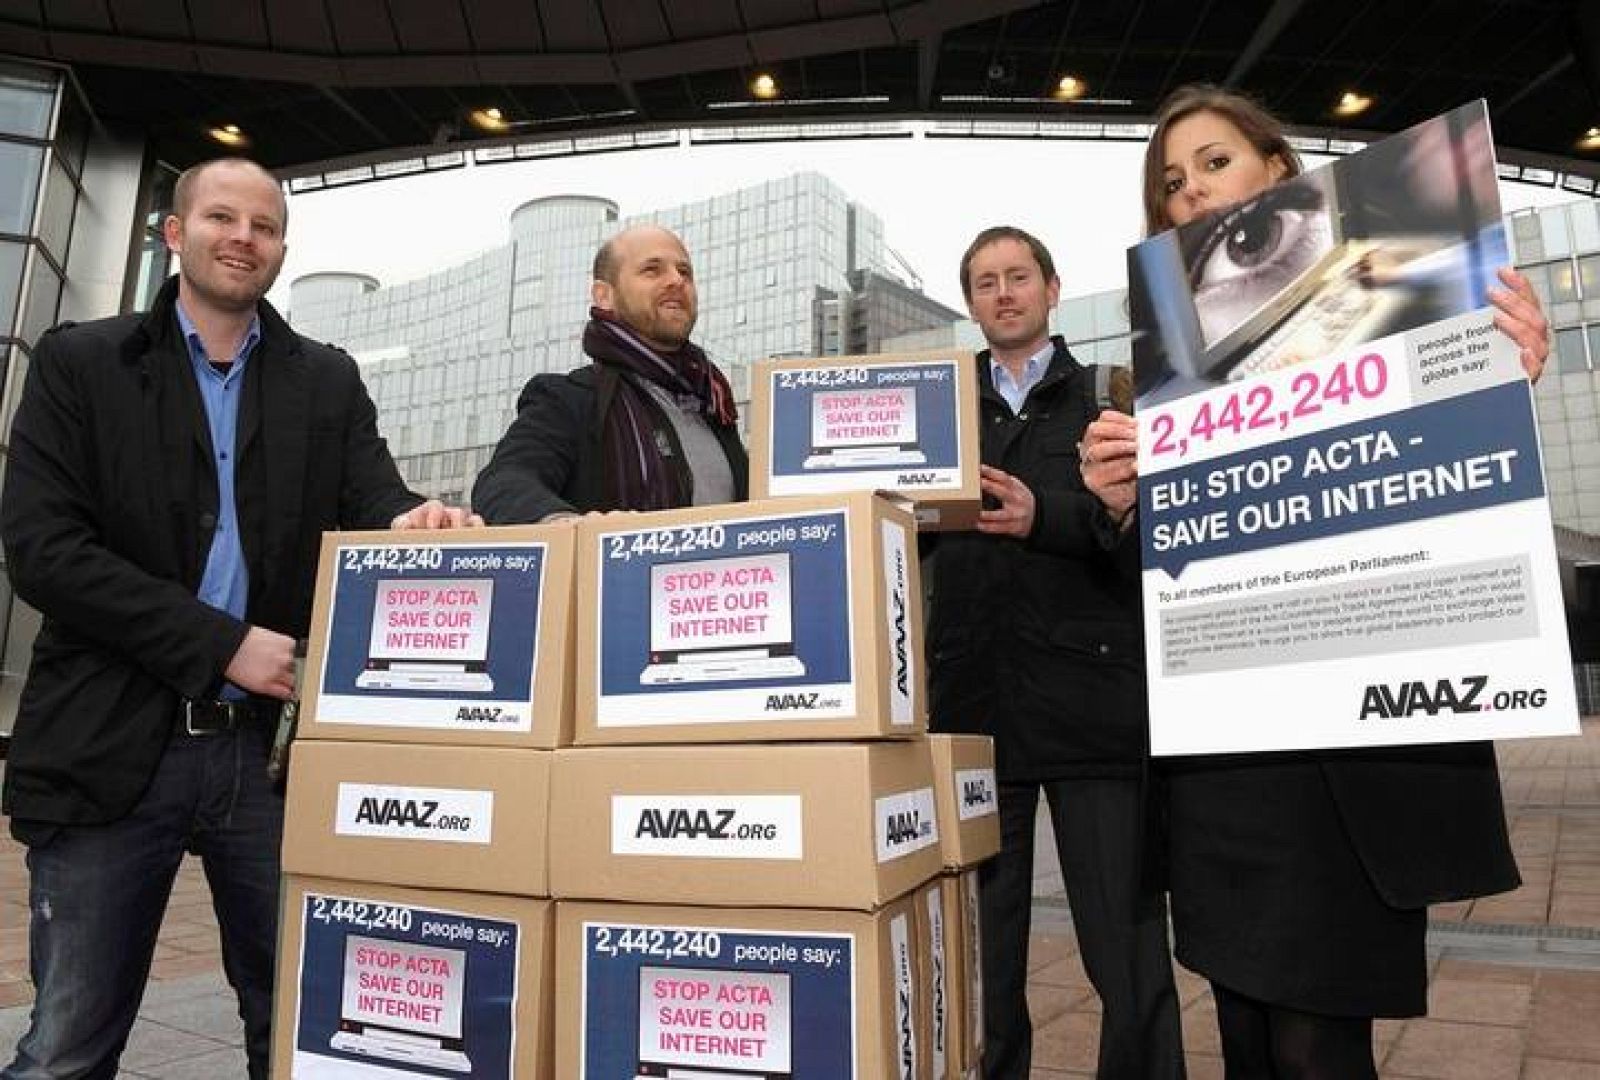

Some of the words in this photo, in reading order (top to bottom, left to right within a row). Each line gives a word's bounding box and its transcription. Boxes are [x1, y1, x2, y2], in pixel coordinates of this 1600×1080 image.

[1418, 332, 1462, 354] people
[1420, 350, 1464, 368] across
[1467, 342, 1489, 354] the
[780, 369, 869, 389] 2,442,240
[878, 370, 920, 384] people
[924, 370, 949, 381] say:
[1422, 366, 1458, 384] globe
[1462, 358, 1491, 374] say:
[822, 396, 863, 410] STOP
[866, 394, 905, 408] ACTA
[1151, 352, 1388, 456] 2,442,240
[826, 412, 862, 425] SAVE
[868, 410, 901, 422] OUR
[826, 424, 900, 439] INTERNET
[1152, 476, 1199, 512] EU:
[1207, 454, 1293, 498] STOP
[1302, 430, 1398, 478] ACTA
[1409, 436, 1423, 446] -
[1152, 513, 1230, 551] SAVE
[1238, 496, 1311, 535] OUR
[1322, 450, 1519, 519] INTERNET
[610, 527, 724, 561] 2,442,240
[736, 528, 796, 548] people
[801, 524, 837, 544] say:
[345, 549, 442, 574] 2,442,240
[451, 555, 502, 570] people
[505, 556, 536, 572] say:
[664, 570, 718, 592] STOP
[720, 567, 774, 588] ACTA
[1159, 590, 1172, 602] To
[1189, 582, 1242, 596] members
[1246, 579, 1258, 590] of
[1260, 575, 1281, 586] the
[1284, 564, 1347, 582] European
[1350, 550, 1432, 572] Parliament:
[386, 590, 430, 606] STOP
[433, 590, 479, 606] ACTA
[669, 596, 718, 616] SAVE
[724, 591, 768, 610] OUR
[388, 612, 430, 628] SAVE
[434, 612, 472, 628] OUR
[670, 615, 770, 639] INTERNET
[386, 633, 470, 650] INTERNET
[1360, 676, 1547, 720] AVAAZ.ORG
[355, 797, 470, 831] AVAAZ.ORG
[635, 809, 776, 840] AVAAZ.ORG
[312, 900, 412, 932] 2,442,240
[422, 921, 474, 942] people
[478, 928, 510, 948] say:
[595, 928, 721, 958] 2,442,240
[734, 943, 799, 966] people
[802, 946, 842, 968] say:
[356, 950, 401, 969] STOP
[405, 954, 450, 978] ACTA
[359, 973, 400, 994] SAVE
[406, 979, 444, 1000] OUR
[654, 979, 710, 1002] STOP
[716, 984, 774, 1006] ACTA
[358, 996, 442, 1024] INTERNET
[659, 1006, 712, 1028] SAVE
[718, 1010, 766, 1032] OUR
[659, 1032, 766, 1058] INTERNET
